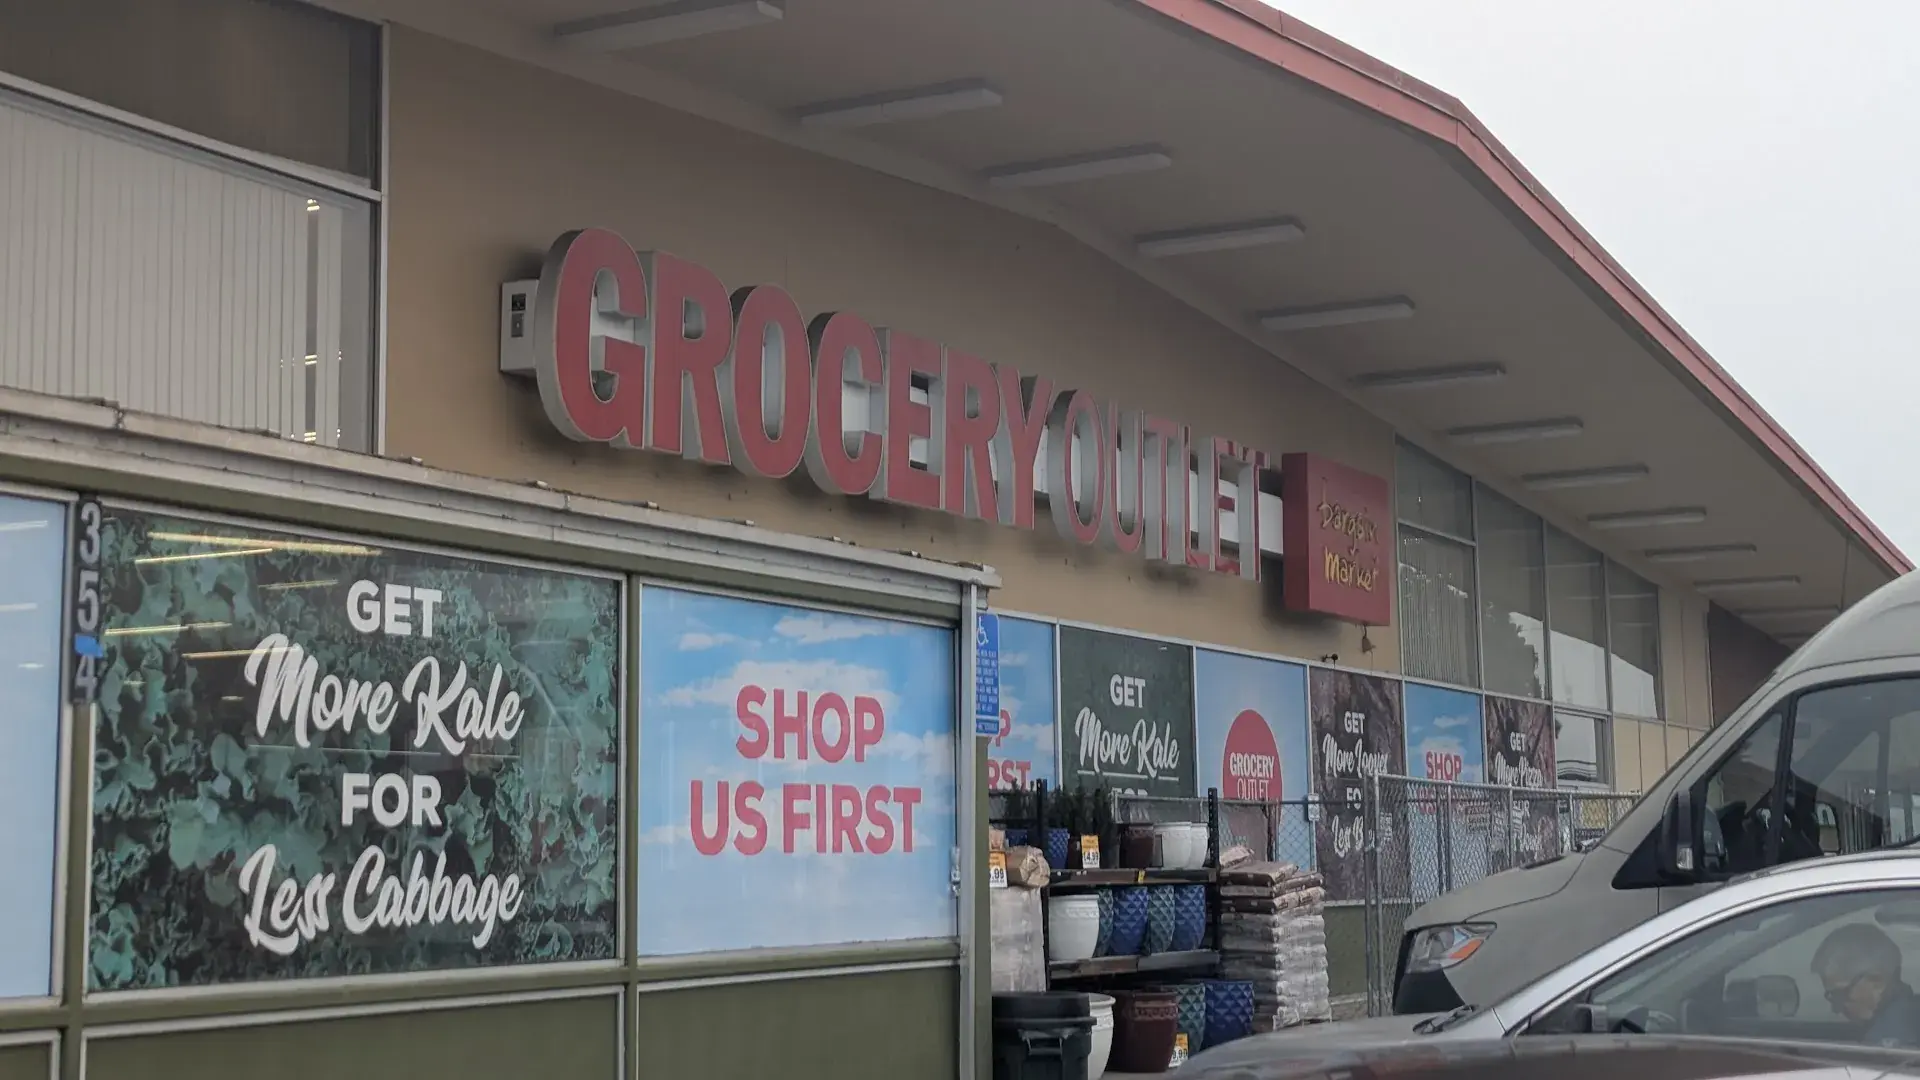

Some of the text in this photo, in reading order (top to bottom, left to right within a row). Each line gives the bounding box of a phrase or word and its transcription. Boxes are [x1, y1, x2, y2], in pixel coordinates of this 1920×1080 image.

[537, 228, 1271, 583] GROCERY OUTLET
[347, 580, 442, 637] GET
[244, 633, 524, 755] More Kale
[1110, 674, 1146, 708] GET
[736, 684, 885, 763] SHOP
[1075, 706, 1131, 773] More
[1131, 718, 1180, 778] Kale
[1344, 710, 1365, 734] GET
[1510, 731, 1526, 752] GET
[987, 760, 1031, 790] RST
[1229, 751, 1275, 779] GROCERY
[1323, 733, 1355, 778] More
[1426, 751, 1462, 781] SHOP
[341, 773, 442, 827] FOR
[1237, 778, 1269, 802] OUTLET
[1346, 787, 1362, 809] FO
[690, 780, 922, 856] US FIRST
[239, 844, 524, 955] Less Cabbage
